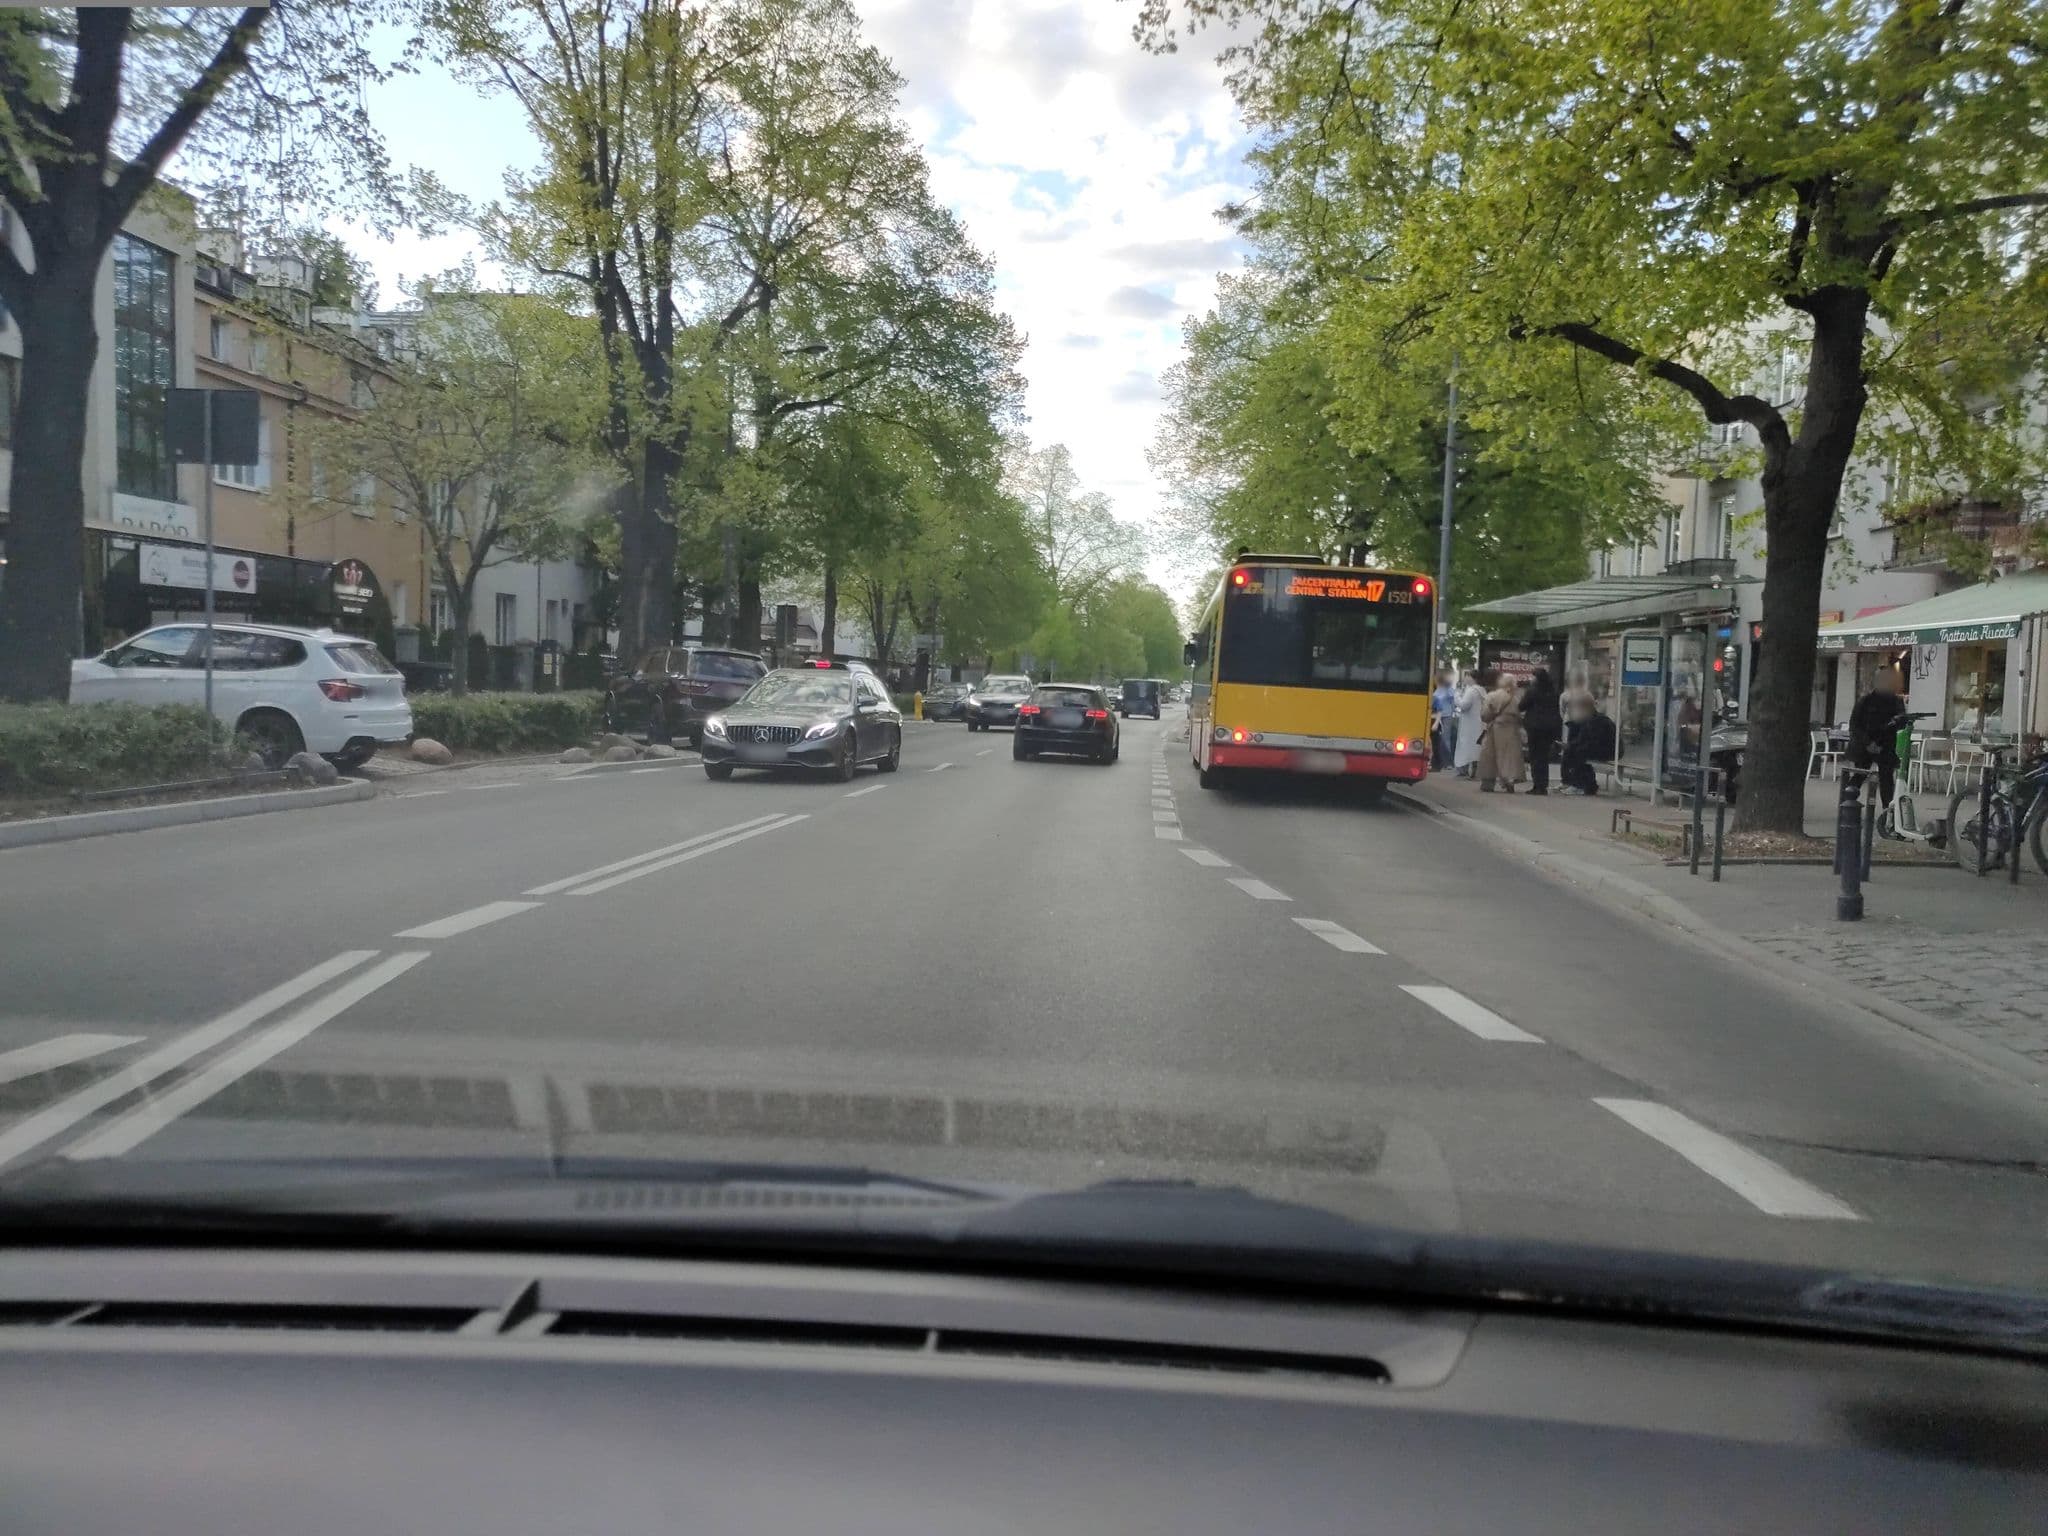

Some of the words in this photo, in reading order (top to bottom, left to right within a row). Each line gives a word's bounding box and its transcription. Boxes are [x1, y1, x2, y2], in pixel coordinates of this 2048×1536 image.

[1285, 585, 1325, 596] CENTRAL
[1328, 588, 1367, 599] STATION
[1388, 591, 1412, 605] 1521
[1857, 634, 1889, 647] Trattoria
[1939, 628, 1979, 643] Trattoria
